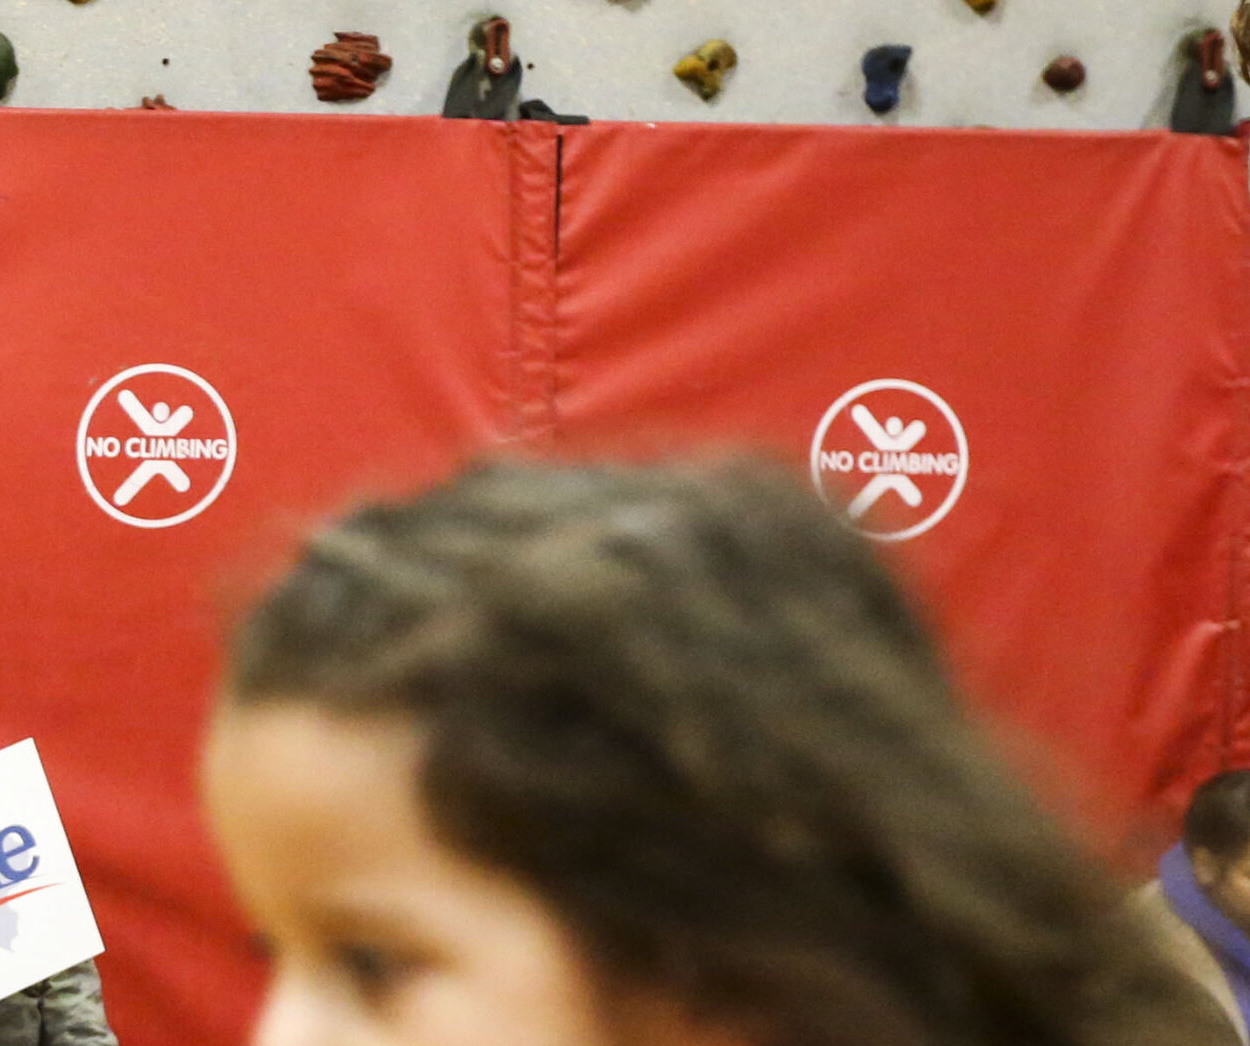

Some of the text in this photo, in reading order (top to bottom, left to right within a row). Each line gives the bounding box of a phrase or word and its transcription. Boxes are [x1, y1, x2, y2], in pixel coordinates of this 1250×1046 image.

[86, 436, 228, 460] NO CLIMBING
[820, 450, 959, 476] NO CLIMBING
